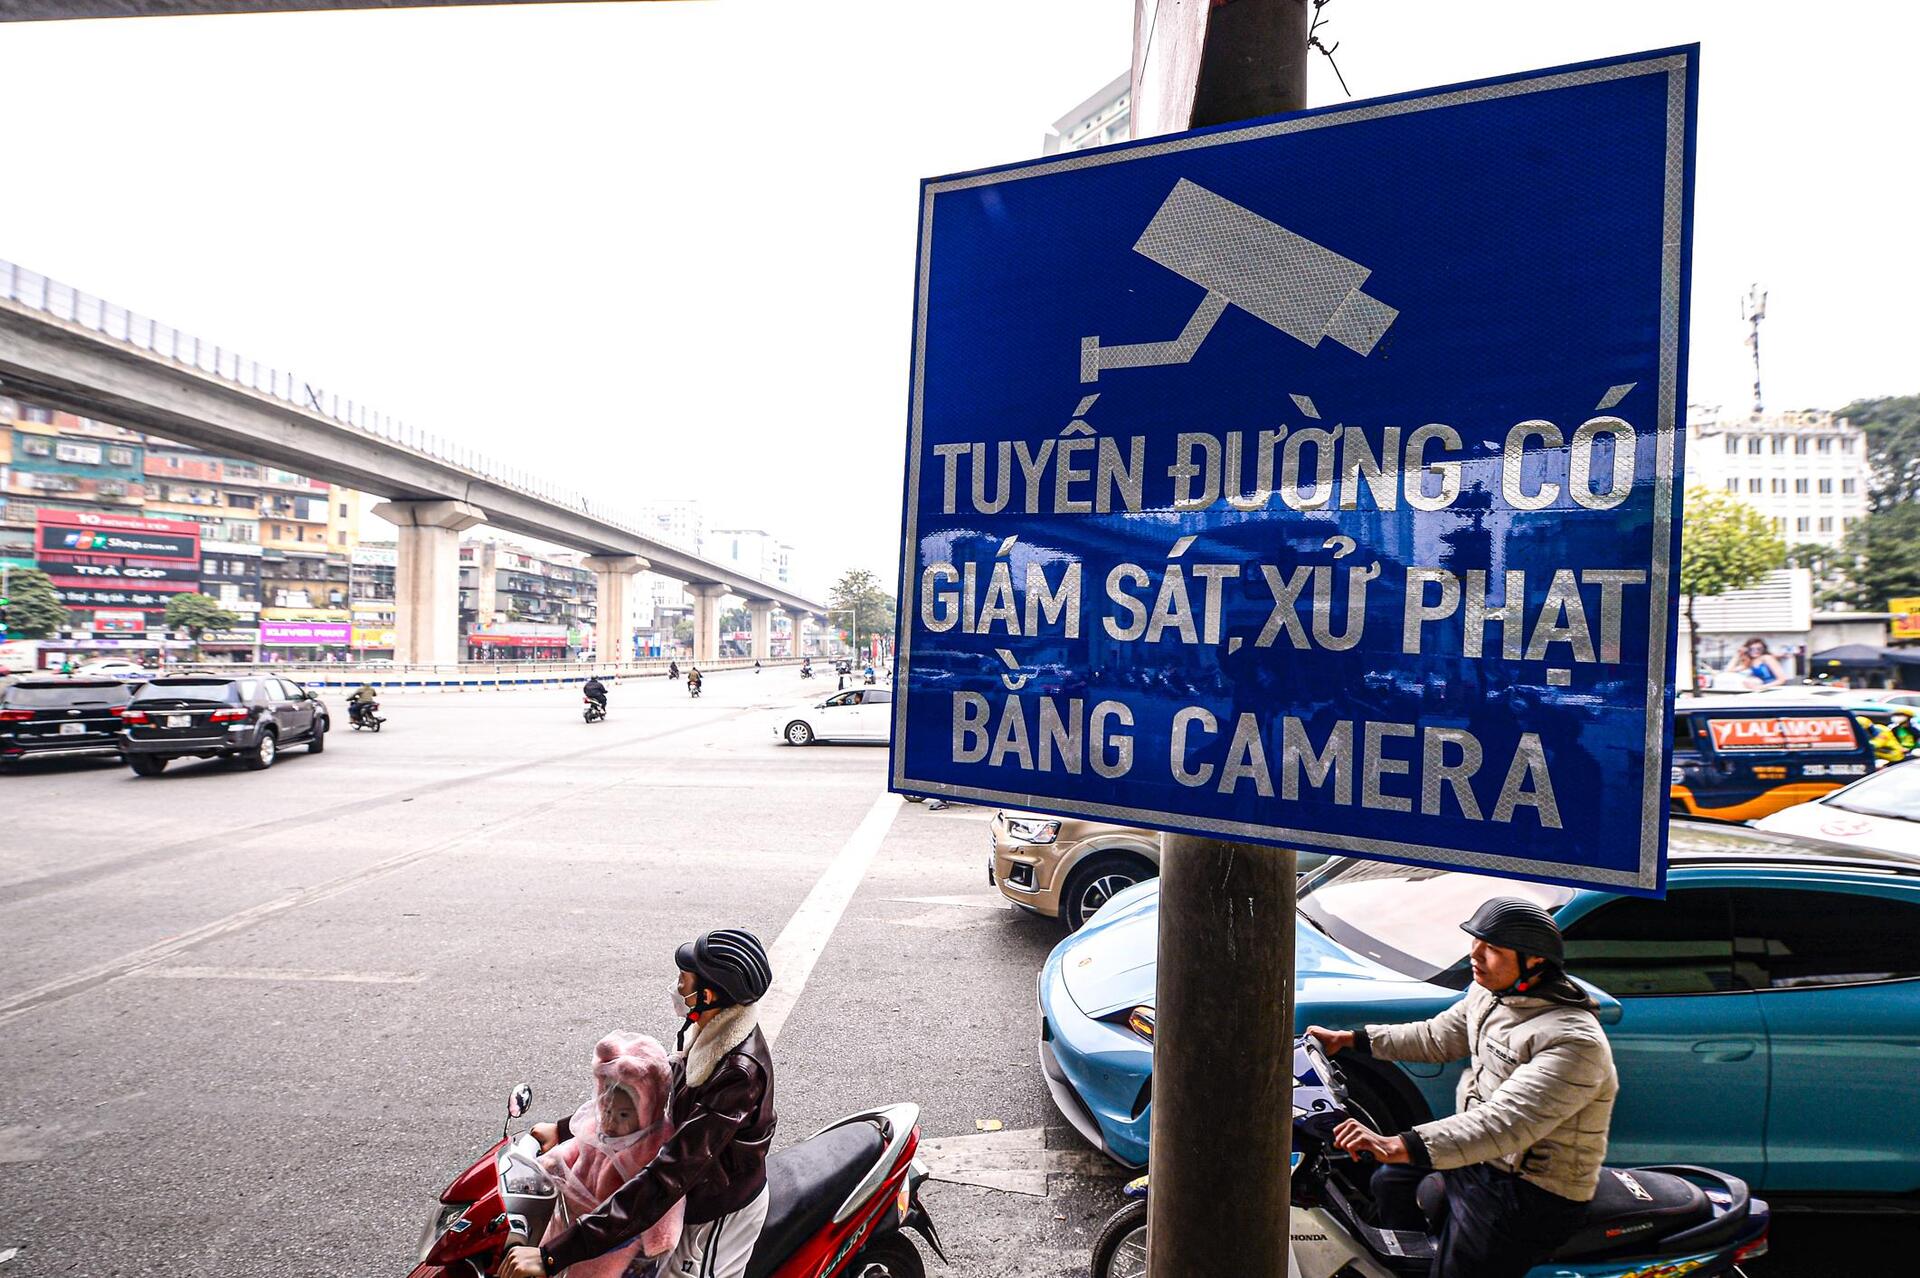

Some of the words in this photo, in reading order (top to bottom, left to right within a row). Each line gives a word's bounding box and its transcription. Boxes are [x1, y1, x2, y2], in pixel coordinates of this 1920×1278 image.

[933, 393, 1146, 515] TUYẾN
[1167, 393, 1463, 512] ĐƯỜNG
[1501, 382, 1637, 511] CÓ
[76, 513, 100, 525] 10
[64, 531, 107, 550] FPT
[72, 565, 120, 577] TRẢ
[123, 567, 167, 578] GÓP
[921, 535, 1083, 639] GIÁM
[1102, 535, 1243, 656] SÁT,
[1254, 535, 1381, 651] XỬ
[1402, 566, 1647, 686] PHẠT
[1735, 719, 1850, 737] LALAMOVE
[952, 648, 1135, 779] BẰNG
[1170, 706, 1563, 830] CAMERA
